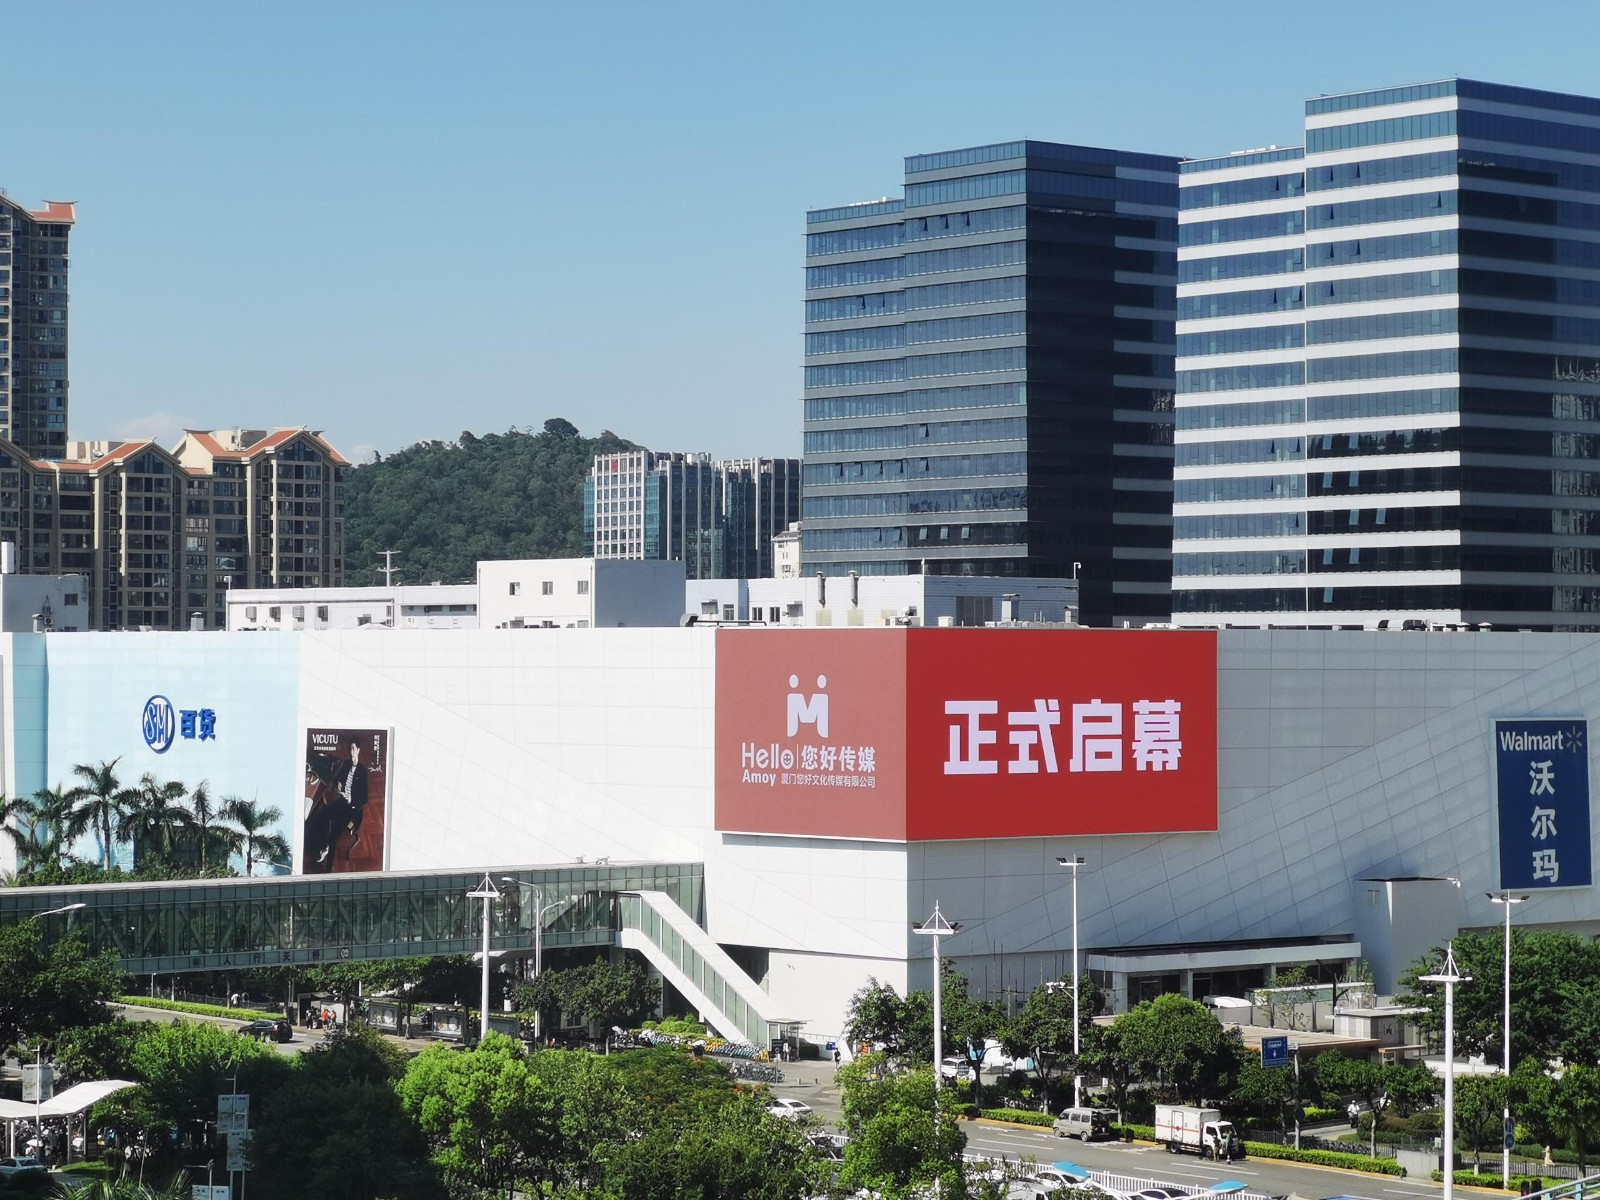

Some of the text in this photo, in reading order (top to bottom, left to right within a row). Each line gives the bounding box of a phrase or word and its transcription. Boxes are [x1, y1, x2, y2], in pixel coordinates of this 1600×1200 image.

[179, 707, 217, 742] 百货
[312, 733, 339, 745] VICUTU
[943, 698, 1183, 776] 正式启幕
[1500, 730, 1563, 752] Walmart
[741, 742, 876, 773] Hello 您好传媒
[742, 769, 876, 789] Amoy 厦门您好文化传媒有限公司
[1528, 759, 1560, 883] 沃尔玛
